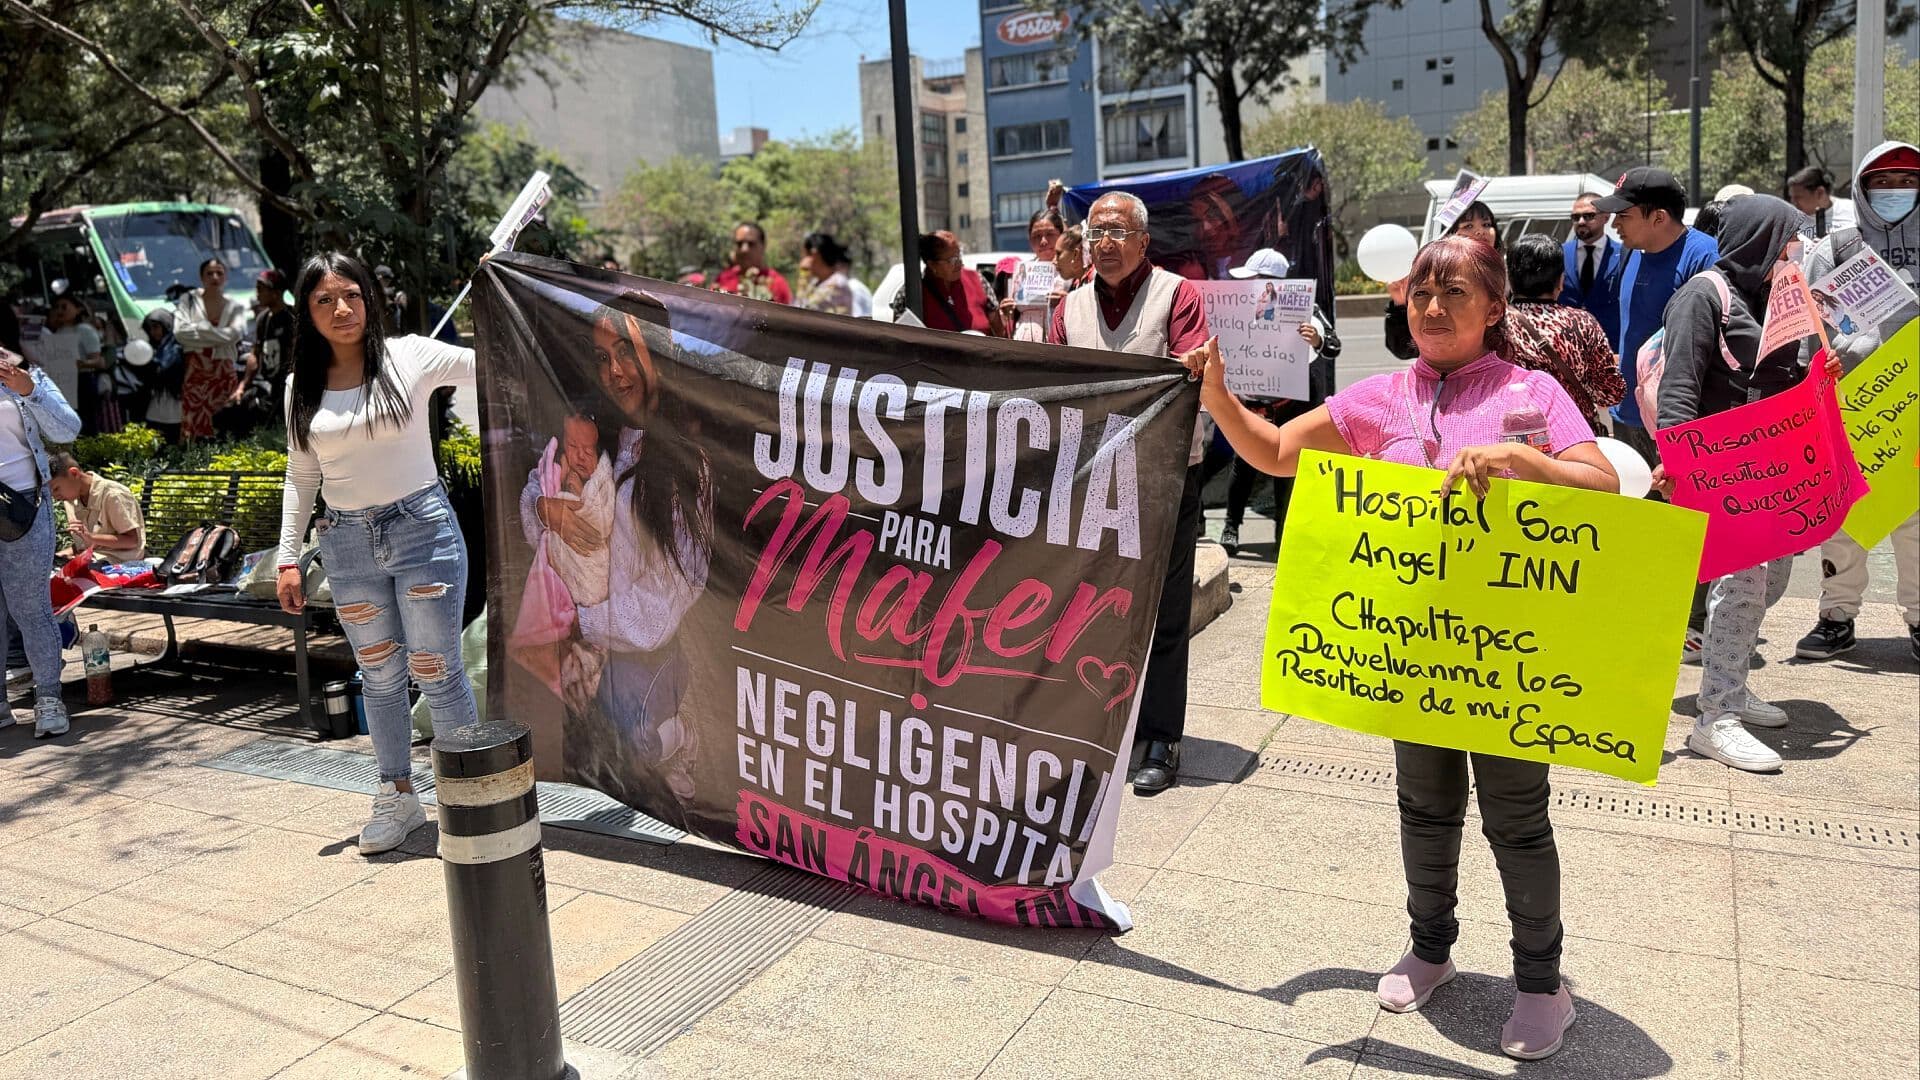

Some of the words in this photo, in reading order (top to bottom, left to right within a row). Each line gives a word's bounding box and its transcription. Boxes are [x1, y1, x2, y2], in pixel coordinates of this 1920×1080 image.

[1004, 11, 1063, 40] Fester
[1833, 258, 1871, 289] JUSTICIA
[1837, 265, 1892, 308] MAFER
[1278, 294, 1311, 307] MAFER
[1239, 344, 1258, 359] 46
[1262, 343, 1295, 364] días
[1849, 419, 1883, 442] 46
[753, 356, 1142, 560] JUSTICIA
[1686, 459, 1790, 493] Resultado
[1721, 461, 1833, 516] Queremos
[878, 511, 951, 571] PARA
[1515, 499, 1602, 552] San
[733, 477, 1133, 687] Mafer
[1486, 550, 1581, 594] INN
[1275, 649, 1405, 704] Resultado
[1419, 687, 1457, 716] de
[1466, 699, 1511, 721] mi
[1289, 622, 1503, 691] Devuelvanme
[1515, 660, 1584, 698] los
[736, 732, 785, 797] EN
[804, 757, 853, 820] EL
[748, 799, 829, 877] SAN
